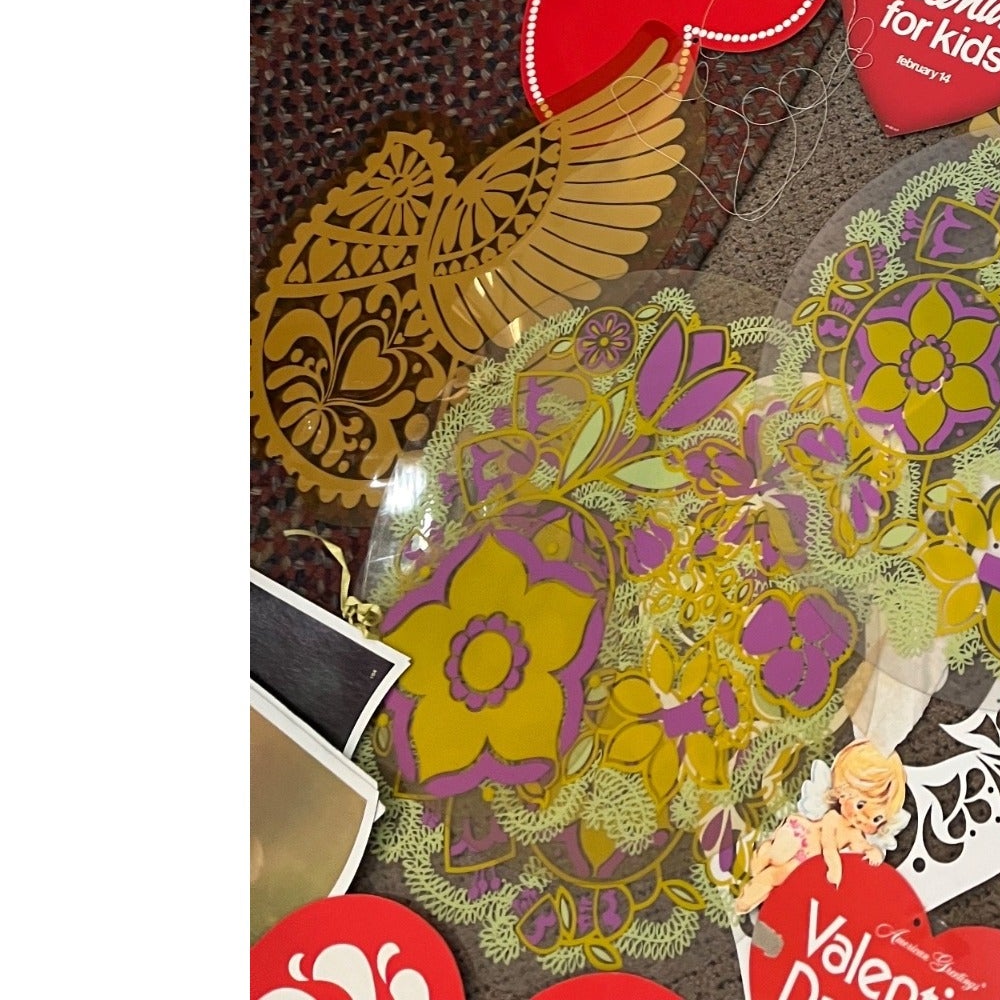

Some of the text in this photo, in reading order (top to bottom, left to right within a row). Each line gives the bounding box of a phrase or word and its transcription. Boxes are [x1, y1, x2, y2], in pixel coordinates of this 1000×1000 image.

[880, 0, 934, 41] for
[896, 55, 952, 84] february 14
